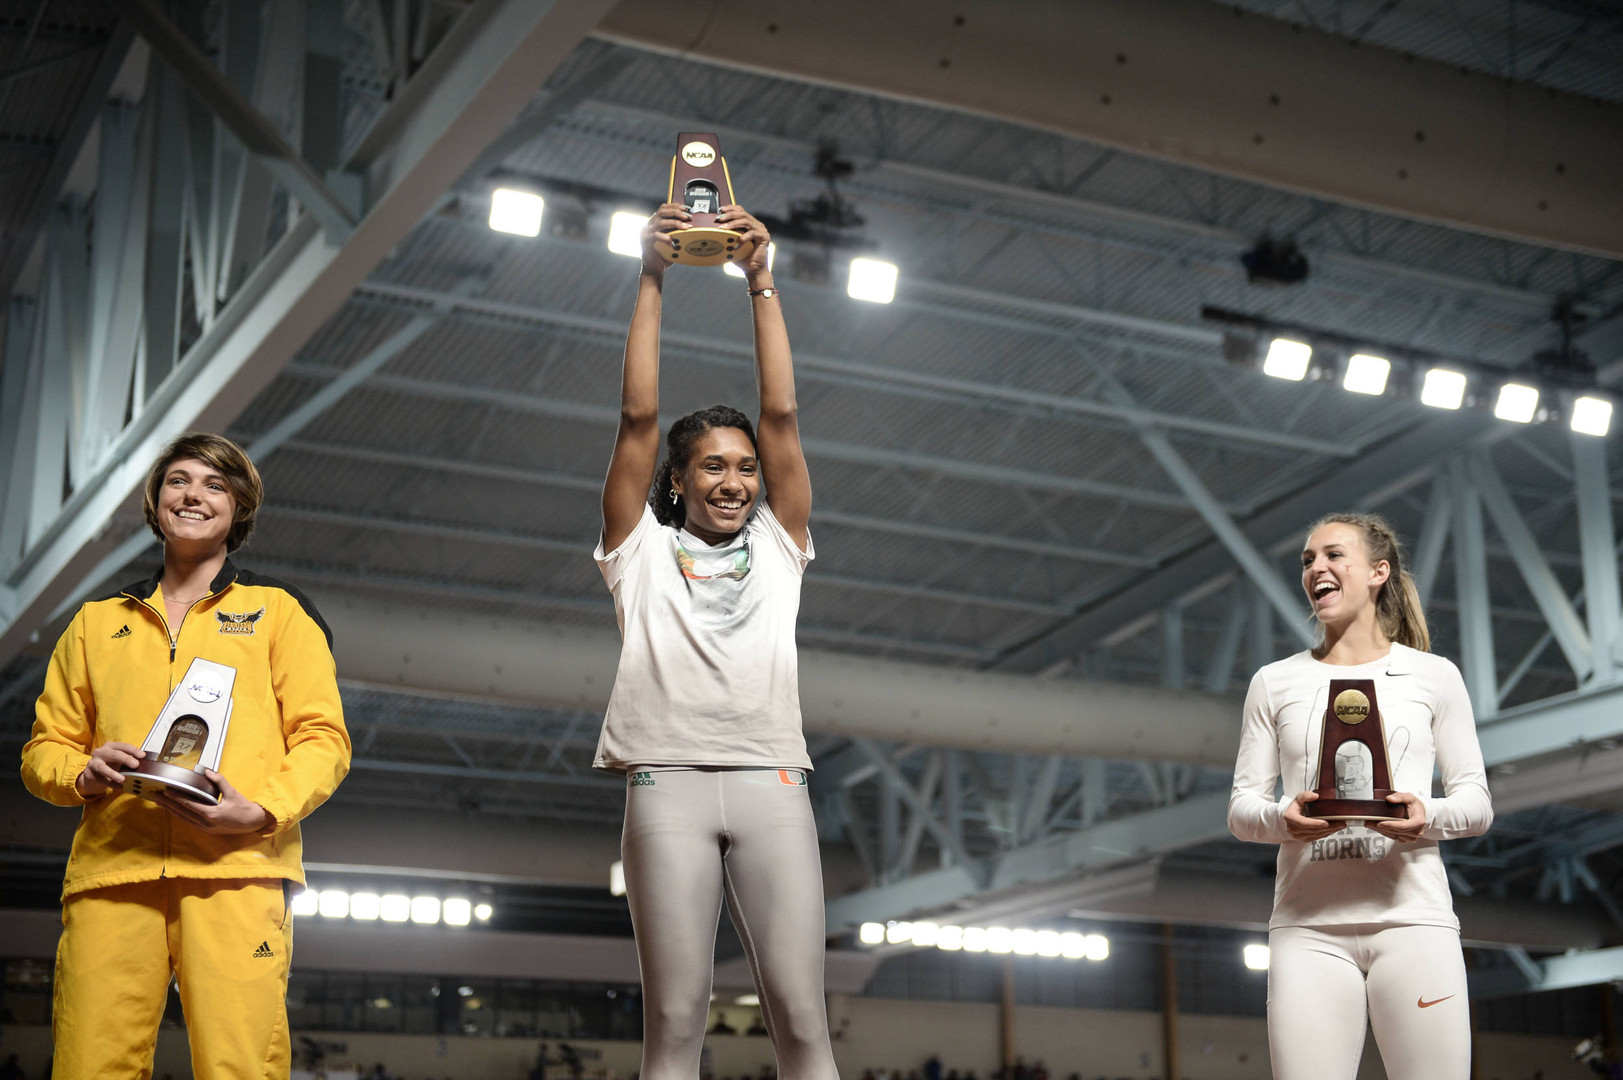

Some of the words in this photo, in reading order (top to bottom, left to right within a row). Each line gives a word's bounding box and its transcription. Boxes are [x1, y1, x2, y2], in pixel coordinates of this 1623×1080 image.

[686, 152, 713, 160] NCAA
[1337, 705, 1368, 716] NCAA
[631, 778, 655, 787] adidas
[1310, 836, 1386, 862] HORNS
